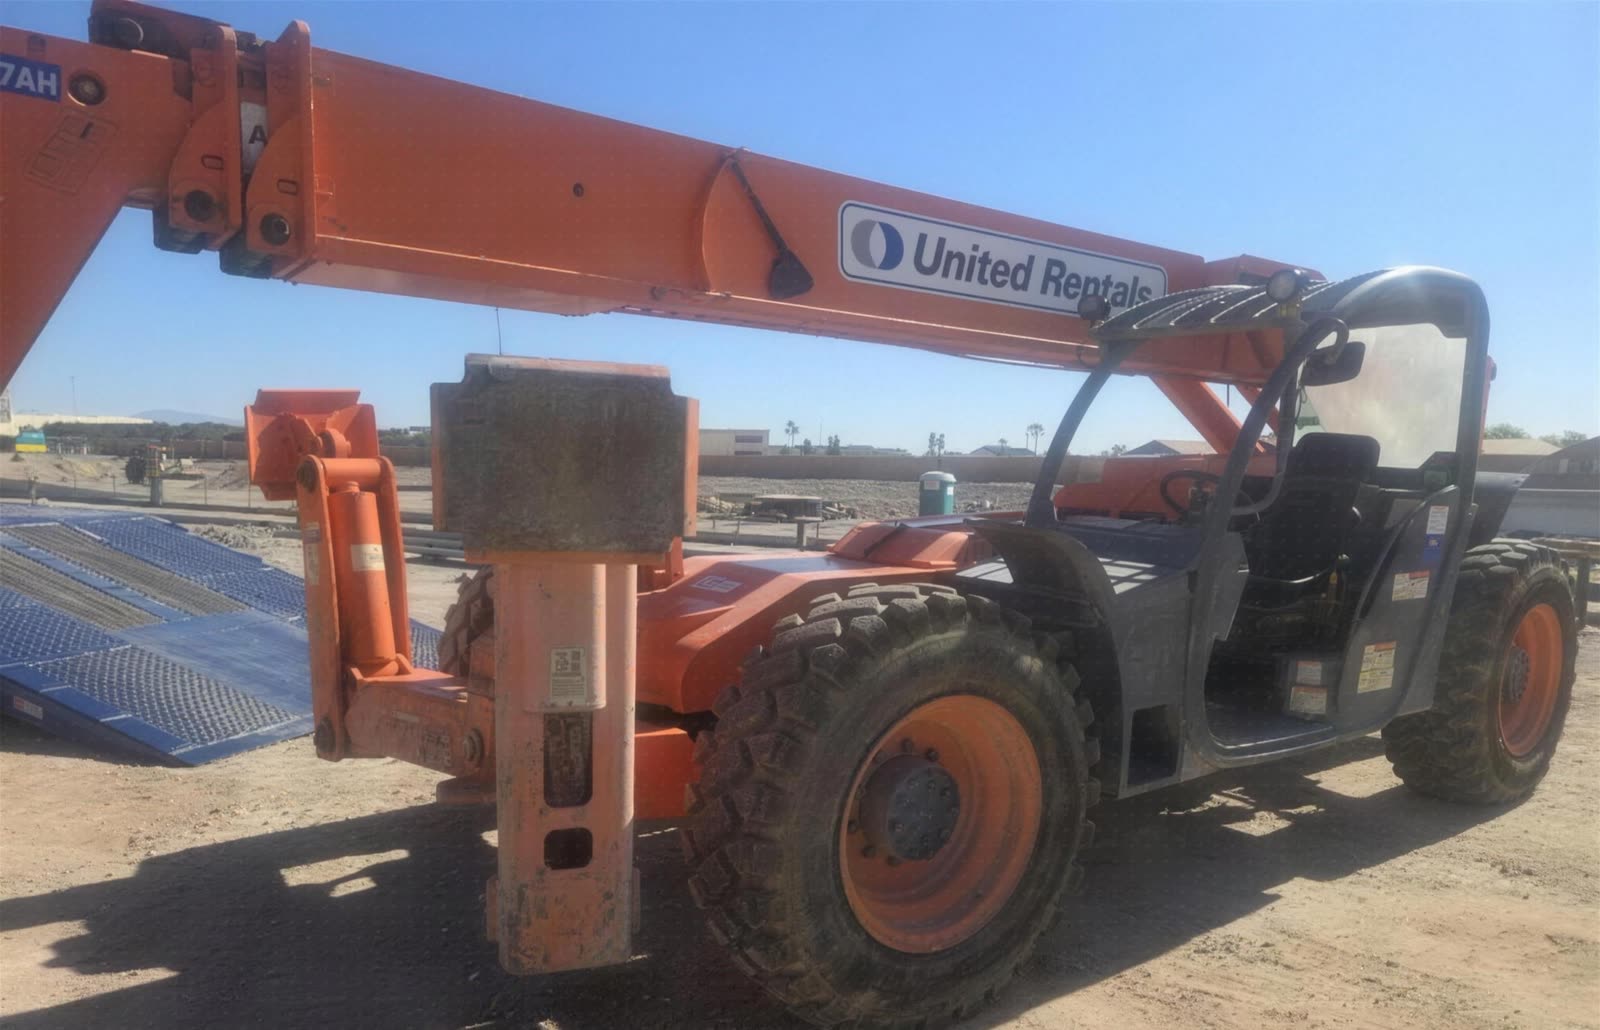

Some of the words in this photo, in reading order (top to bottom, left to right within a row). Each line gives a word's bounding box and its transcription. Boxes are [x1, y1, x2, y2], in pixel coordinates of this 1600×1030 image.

[248, 125, 268, 148] A
[913, 232, 1036, 292] United
[1040, 258, 1153, 309] Rentals
